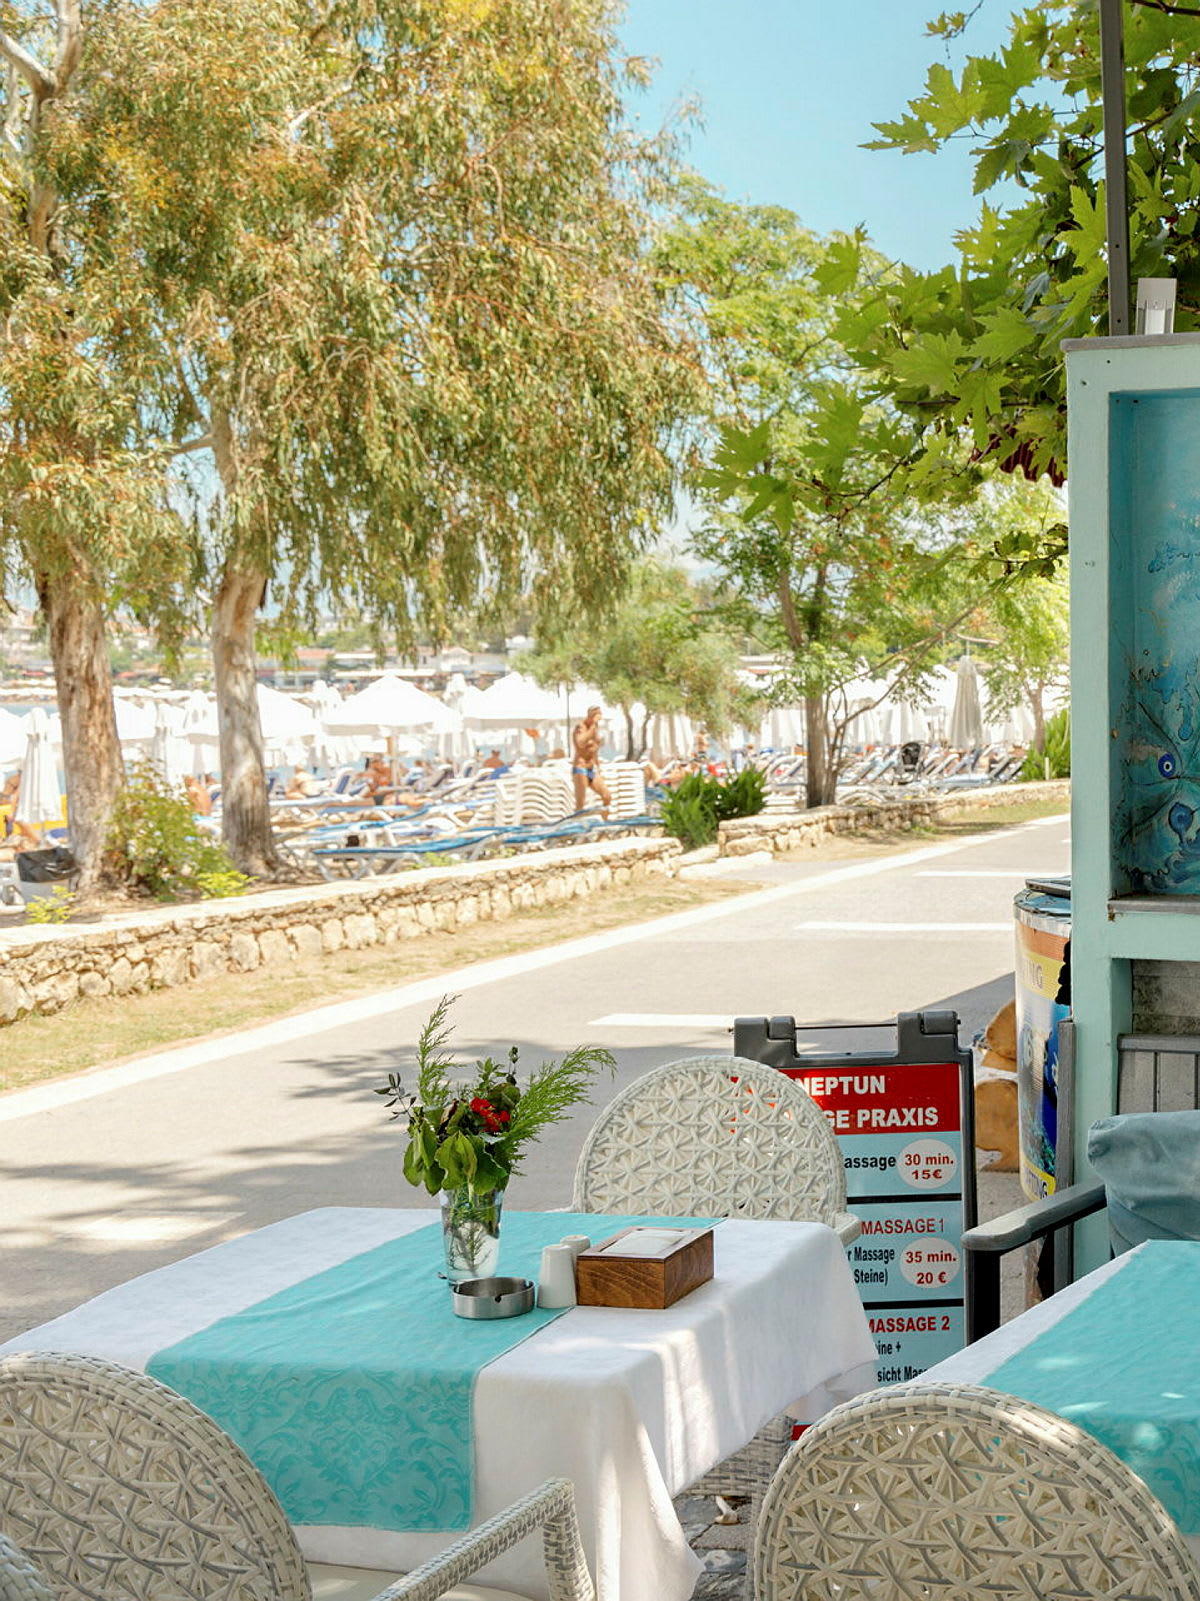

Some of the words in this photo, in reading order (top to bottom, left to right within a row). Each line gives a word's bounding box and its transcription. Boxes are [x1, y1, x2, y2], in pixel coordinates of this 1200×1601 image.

[857, 1106, 939, 1128] PRAXIS
[905, 1154, 921, 1166] 30
[925, 1153, 954, 1166] min.
[912, 1169, 943, 1180] 15€
[861, 1218, 936, 1235] MASSAGE
[854, 1247, 895, 1264] Massage
[905, 1251, 922, 1264] 35
[927, 1250, 957, 1262] min.
[854, 1268, 889, 1286] Steine)
[916, 1272, 934, 1284] 20
[941, 1315, 950, 1331] 2
[875, 1340, 892, 1355] ine
